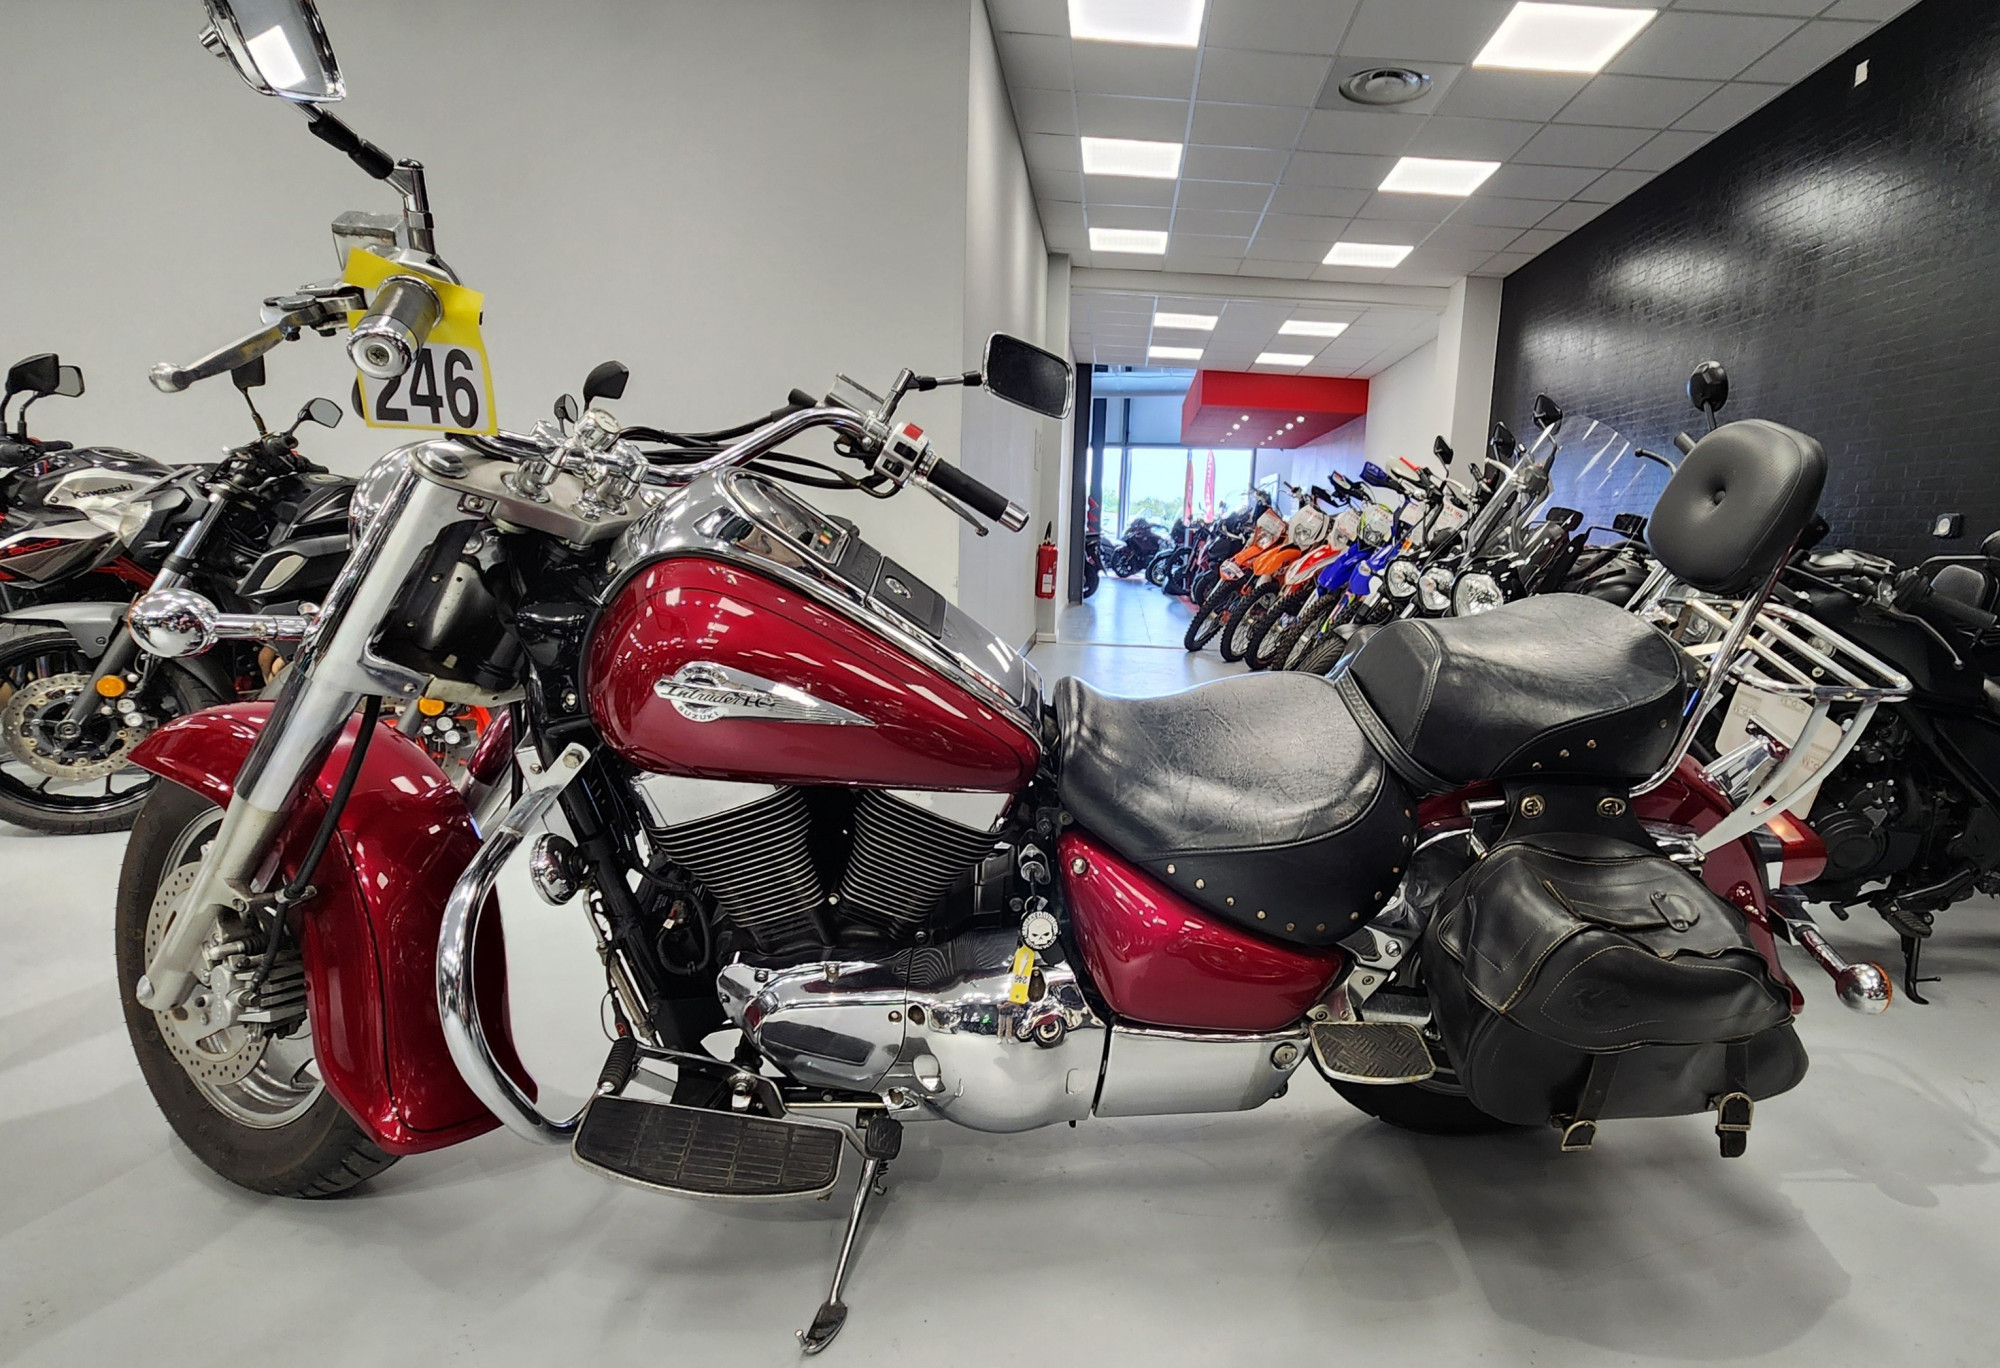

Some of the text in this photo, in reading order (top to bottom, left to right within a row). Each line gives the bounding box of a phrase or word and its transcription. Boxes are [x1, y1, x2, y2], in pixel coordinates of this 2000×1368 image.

[71, 483, 134, 500] Kawasaki
[661, 685, 740, 705] Intruder
[677, 705, 720, 721] SUZUKI
[1014, 974, 1028, 985] 246
